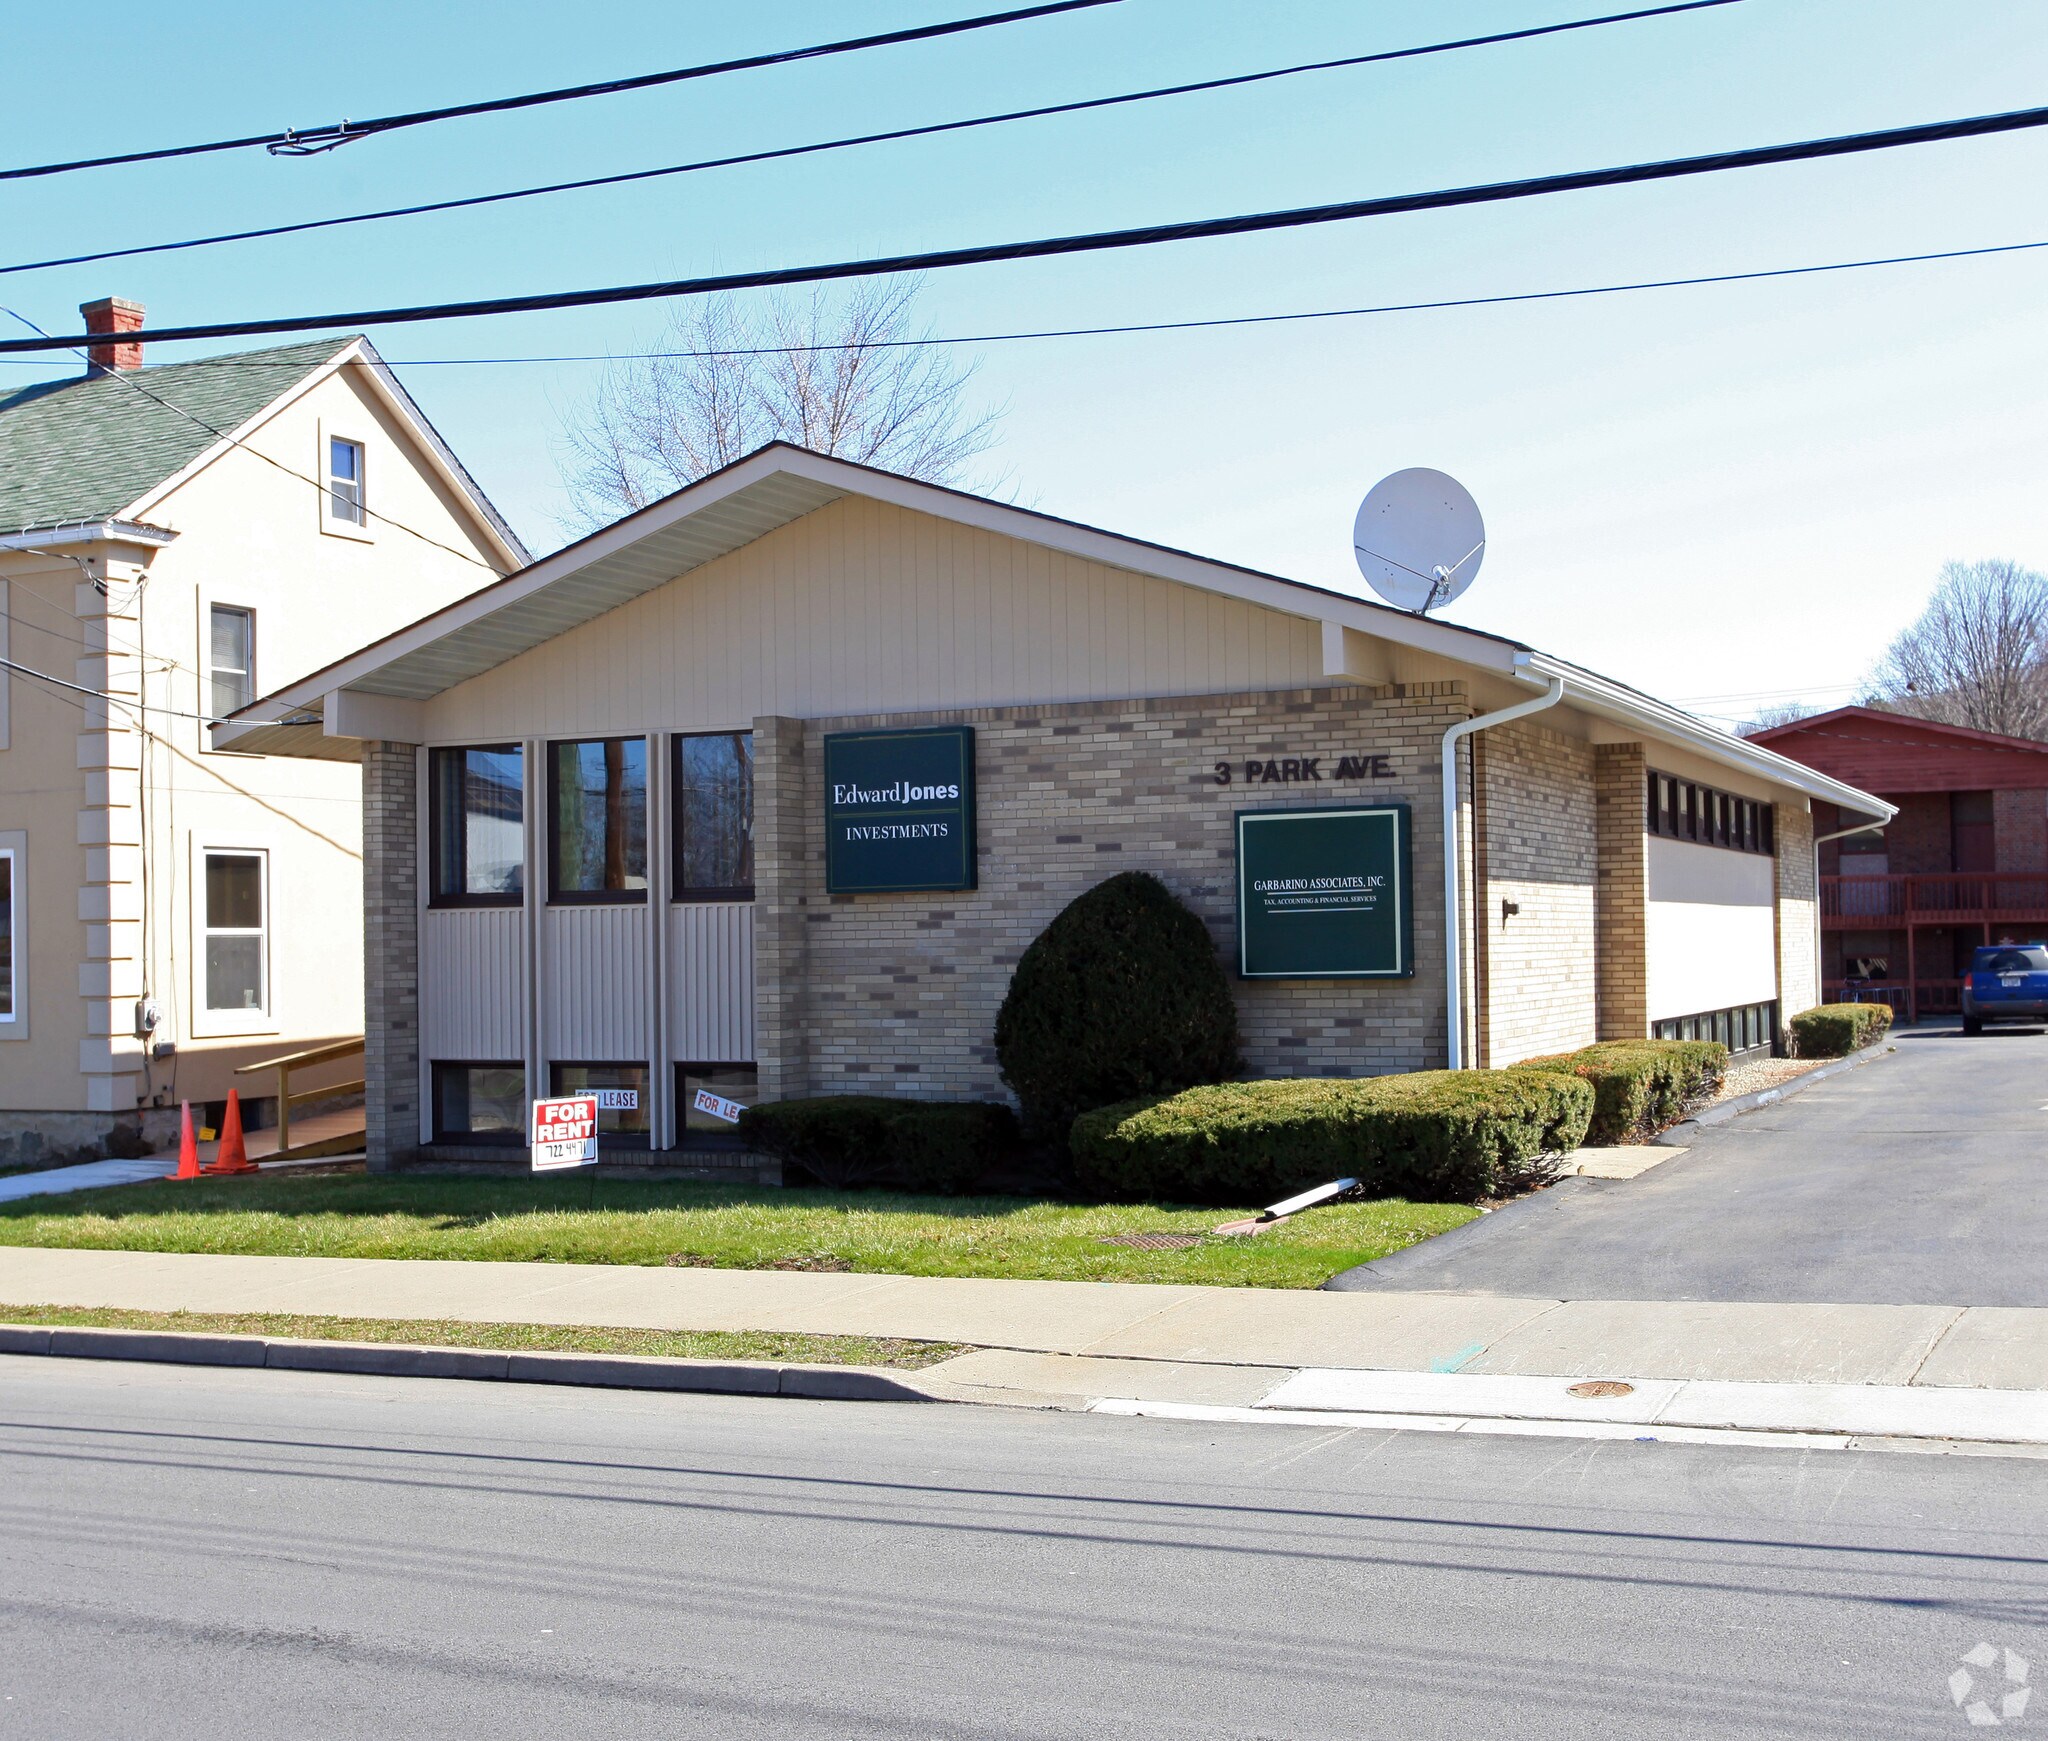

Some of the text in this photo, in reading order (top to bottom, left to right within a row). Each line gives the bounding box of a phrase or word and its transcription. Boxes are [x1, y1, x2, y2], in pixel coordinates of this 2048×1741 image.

[1214, 754, 1397, 785] 3 PARK AVE.
[846, 823, 949, 841] INVESTMENTS
[1254, 875, 1386, 891] GARBARINO ASSOCIATES, INC.
[1277, 897, 1314, 905] ACCOUNTING
[1319, 896, 1350, 904] FINANCIAL
[603, 1092, 635, 1107] LEASE
[698, 1093, 719, 1112] FOR
[545, 1102, 589, 1123] FOR
[537, 1120, 594, 1142] RENT
[545, 1144, 563, 1158] 722
